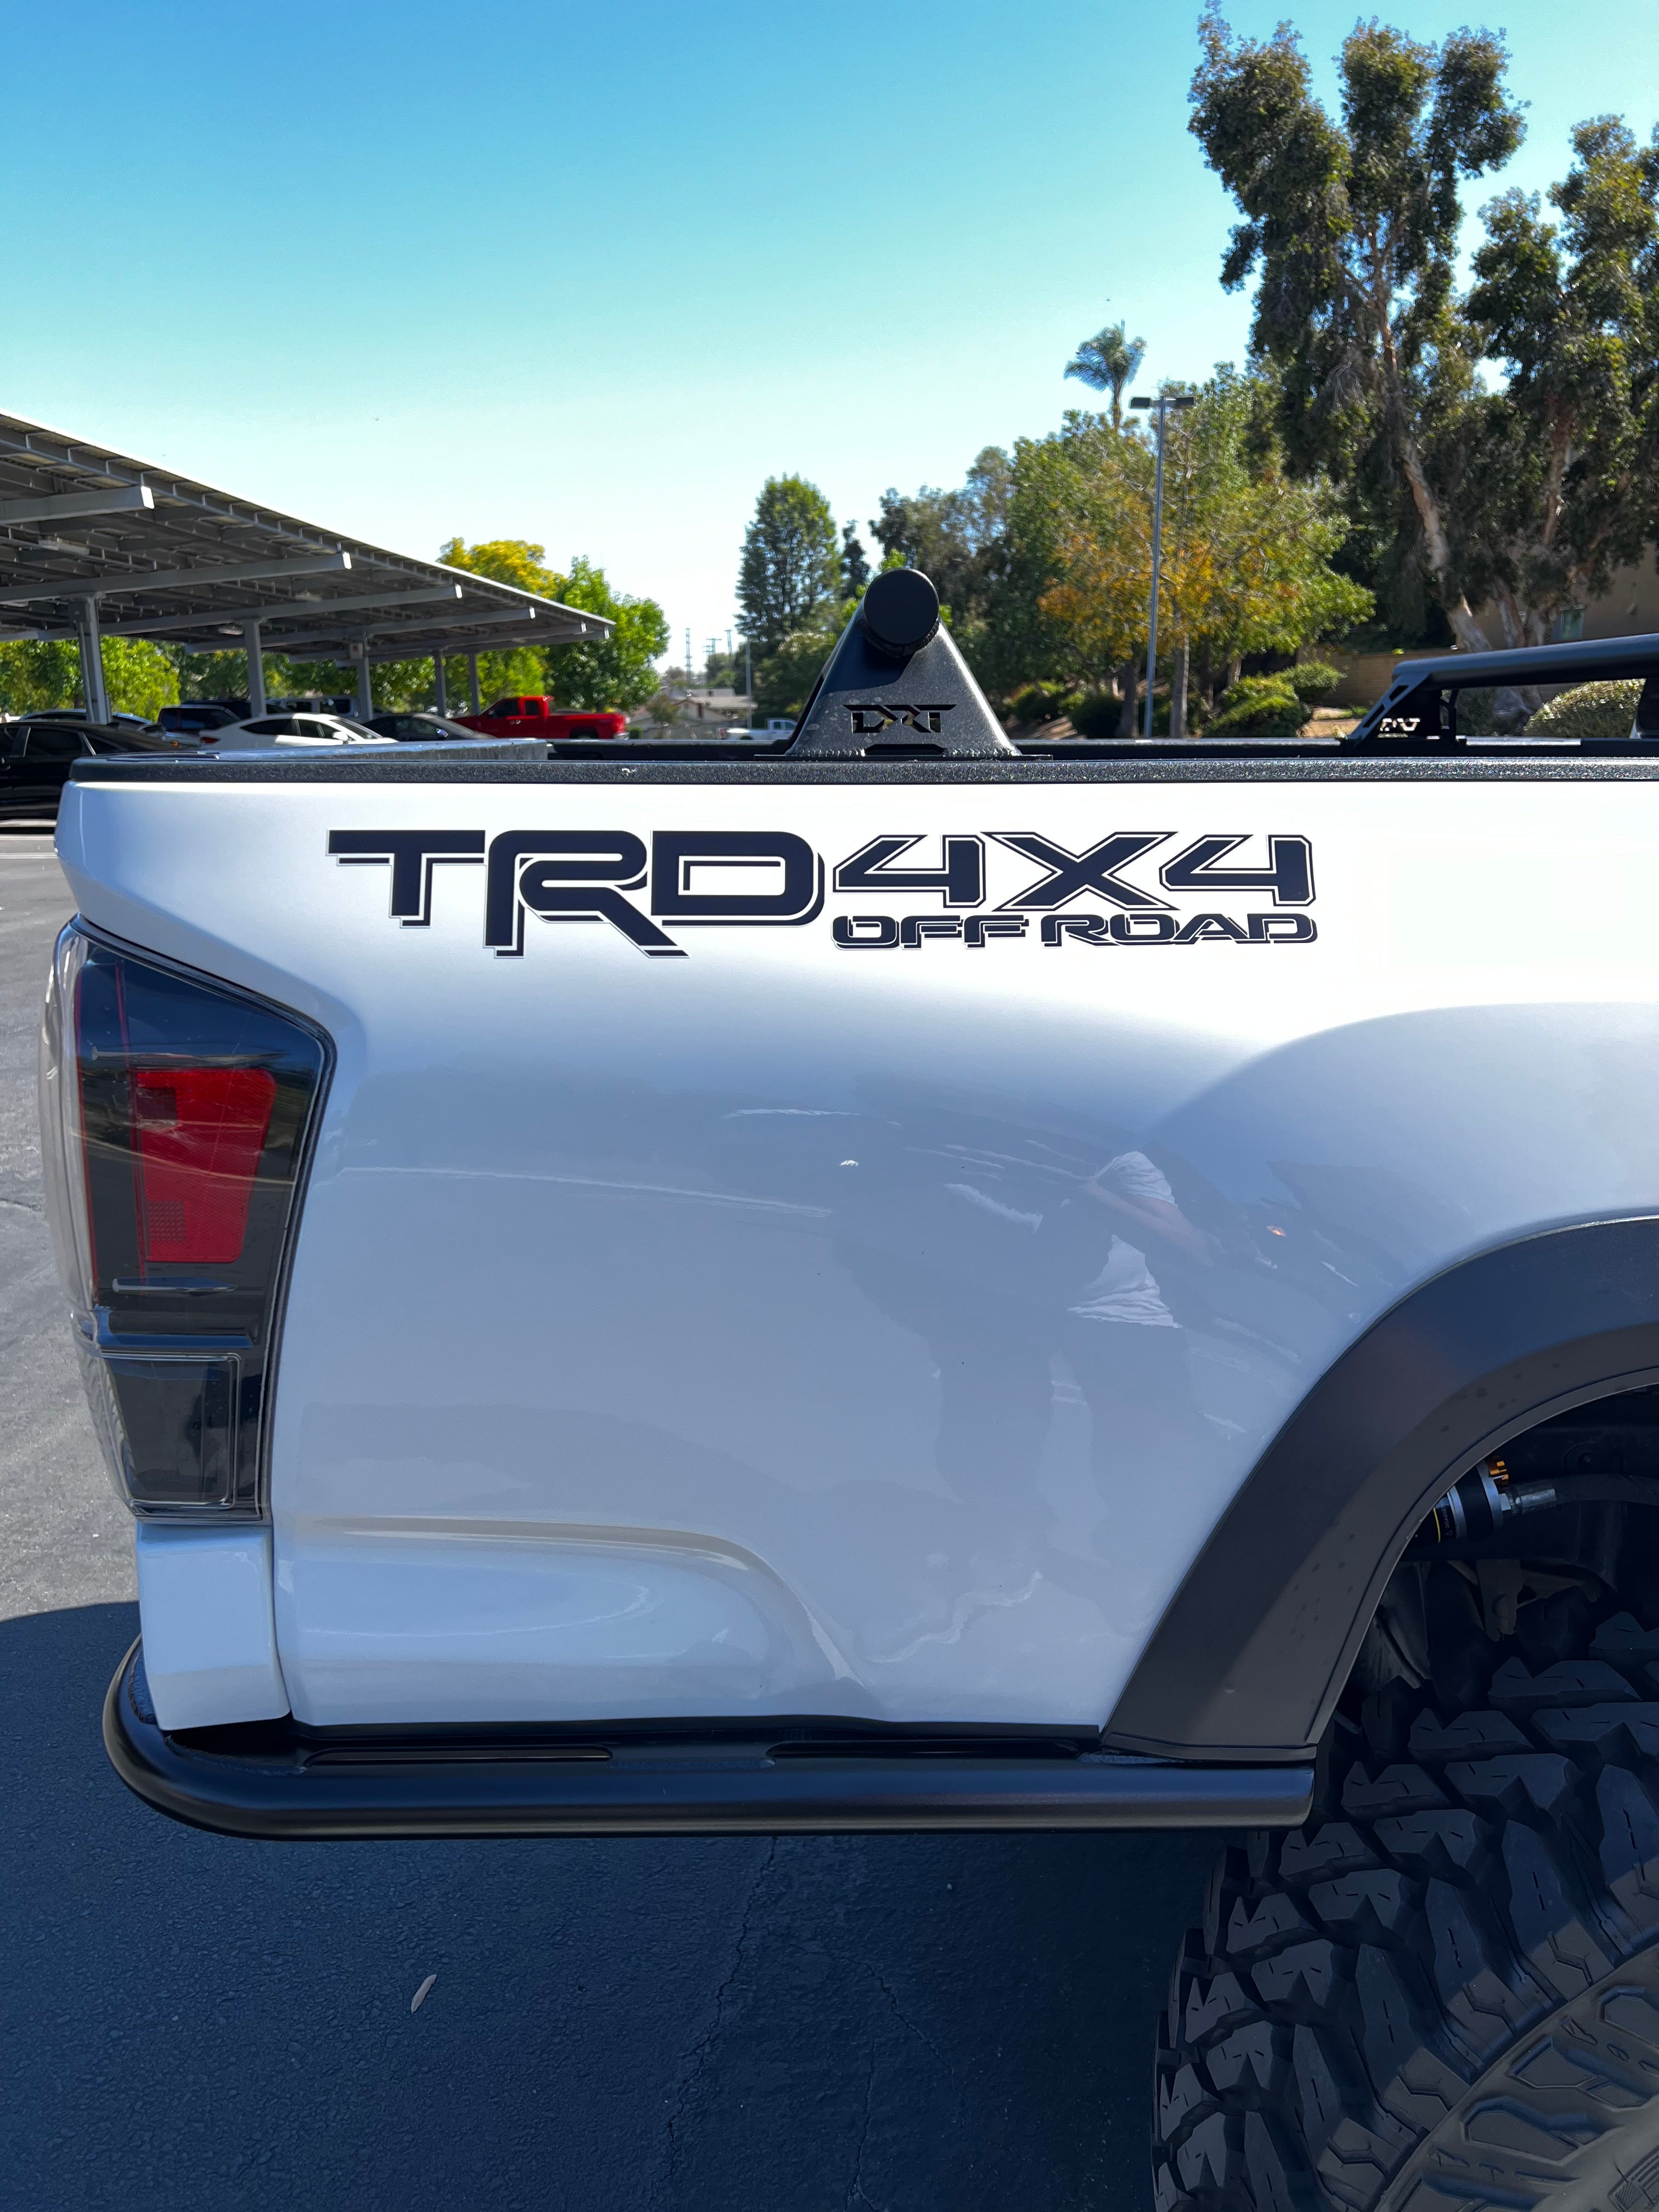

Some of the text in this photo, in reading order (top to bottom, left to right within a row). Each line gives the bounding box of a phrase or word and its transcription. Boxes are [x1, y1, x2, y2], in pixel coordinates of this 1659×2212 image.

[327, 830, 1317, 958] TRD 4X4
[830, 913, 1318, 950] OFF ROAD
